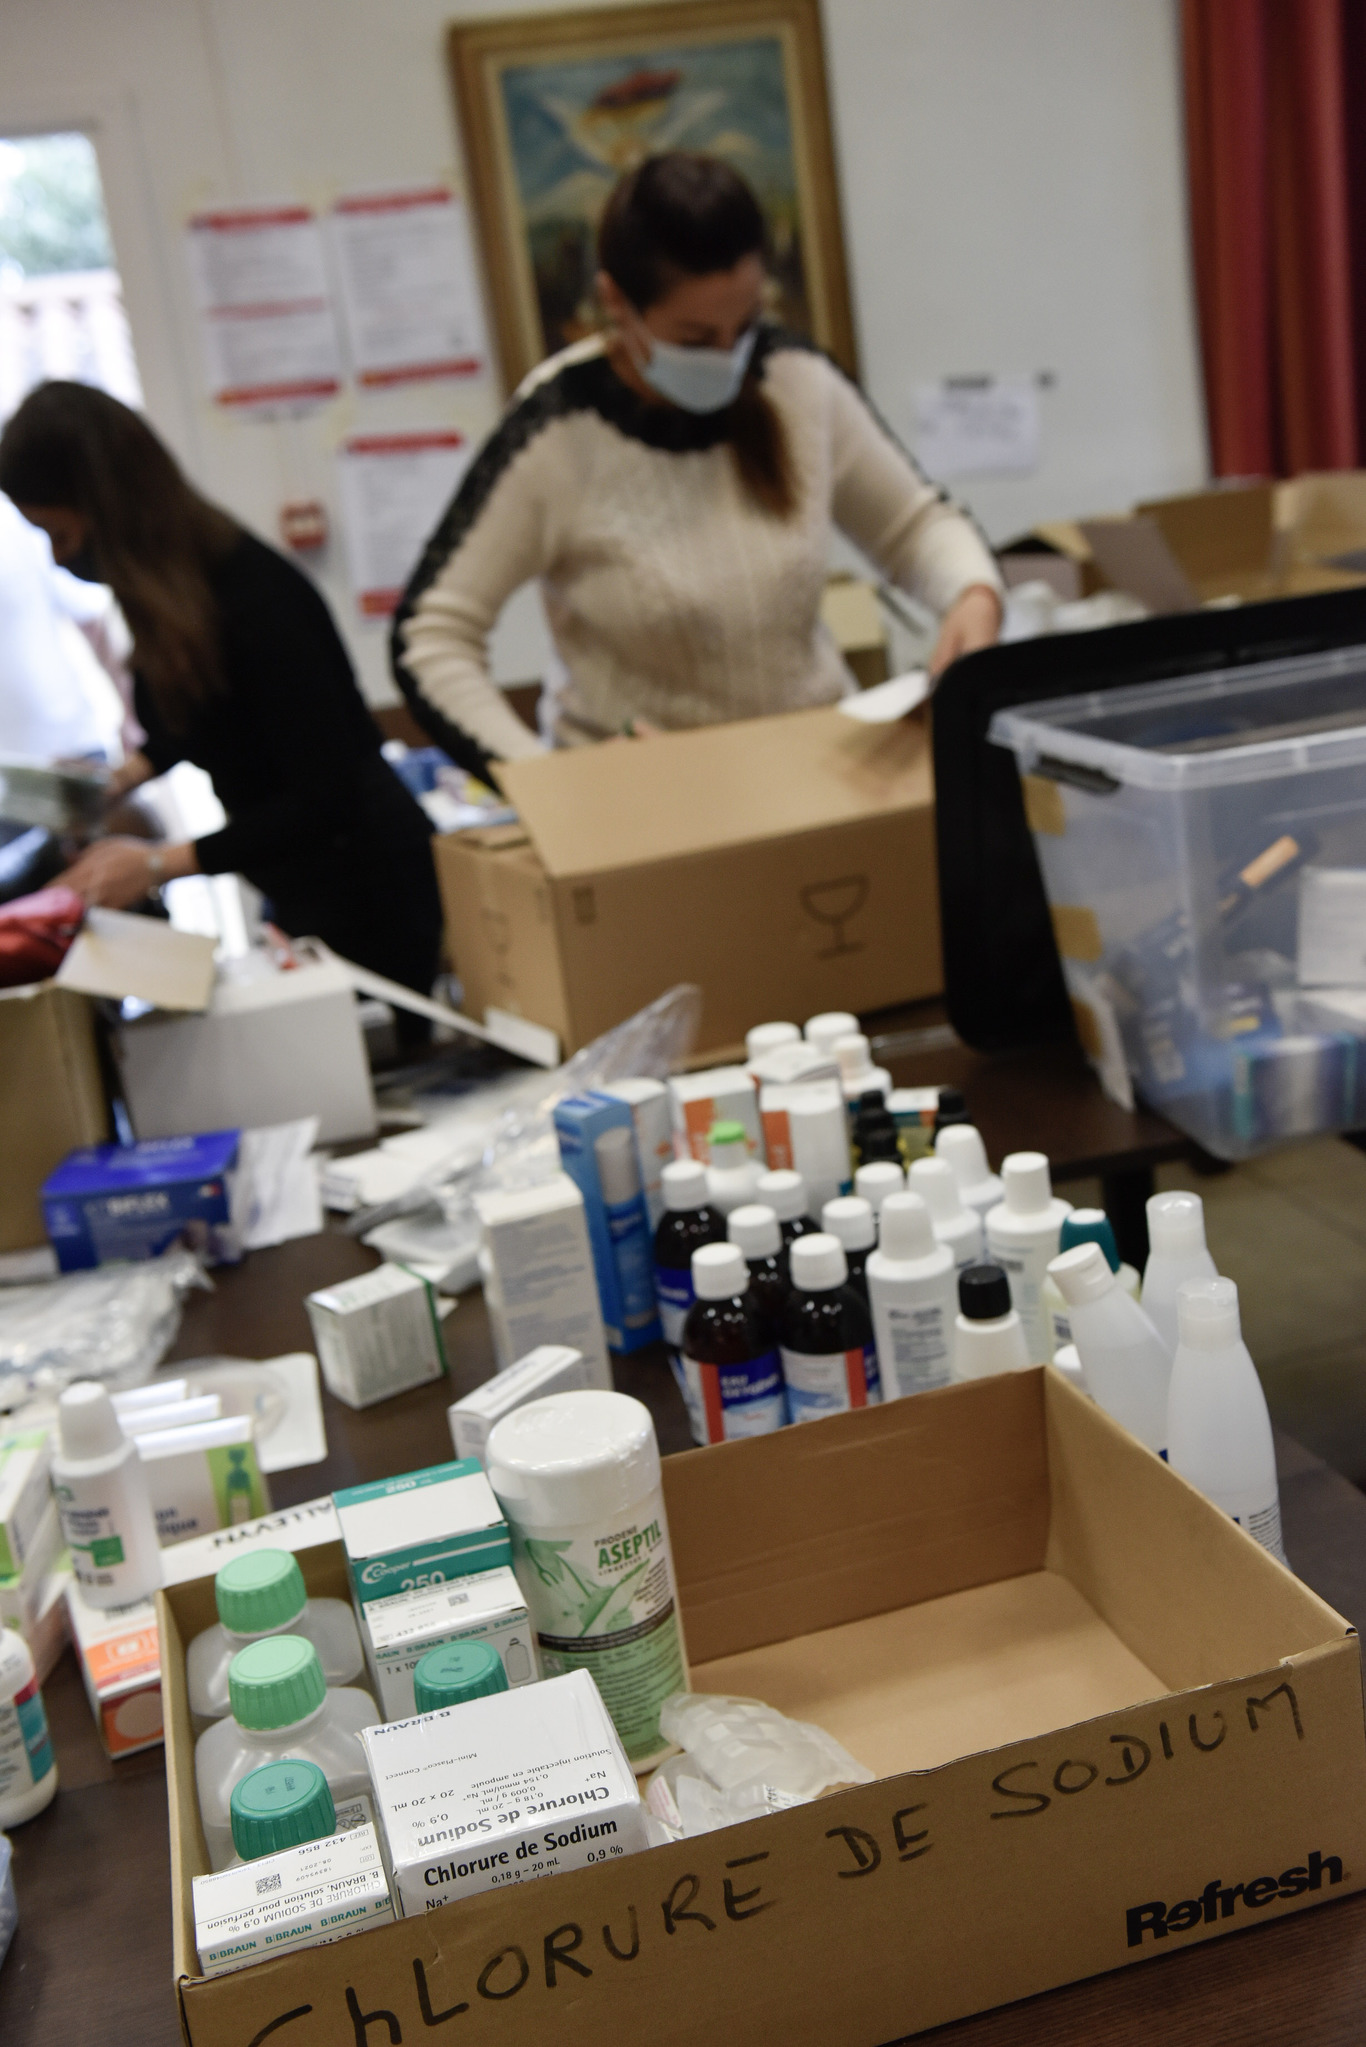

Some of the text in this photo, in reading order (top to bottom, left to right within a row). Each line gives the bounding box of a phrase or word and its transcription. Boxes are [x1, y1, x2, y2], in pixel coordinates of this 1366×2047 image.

[594, 1525, 638, 1548] PRODENE
[597, 1519, 662, 1569] ASEPTIL
[400, 1570, 446, 1592] 250
[385, 1767, 421, 1781] Connect
[470, 1748, 612, 1789] Solution injectable en ampoule
[523, 1773, 549, 1784] 0,154
[825, 1802, 934, 1878] DE
[990, 1682, 1304, 1820] SODIUM
[439, 1789, 455, 1798] 20
[480, 1780, 520, 1795] mmol/mL
[511, 1785, 536, 1796] 0,009
[411, 1796, 427, 1806] 20
[480, 1796, 493, 1805] mL
[523, 1791, 544, 1802] 0,18
[390, 1800, 408, 1812] mL
[476, 1805, 490, 1815] mL
[492, 1802, 505, 1810] 20
[412, 1812, 449, 1828] 0,9 %
[417, 1786, 610, 1847] Chlorure de Sodium
[298, 1844, 321, 1855] 856
[325, 1837, 346, 1848] 432
[424, 1850, 510, 1887] Chlorure
[515, 1840, 540, 1860] de
[543, 1819, 618, 1851] Sodium
[587, 1844, 624, 1864] 0,9 %
[491, 1871, 513, 1885] 0,18
[514, 1870, 522, 1880] g
[531, 1861, 545, 1872] 20
[546, 1856, 560, 1868] mL
[207, 1870, 380, 1930] B. BRAUN, solution pour perfusion
[228, 1880, 382, 1933] CHLORURE DE SODIUM 0,9 %
[1125, 1850, 1343, 1948] Refresh
